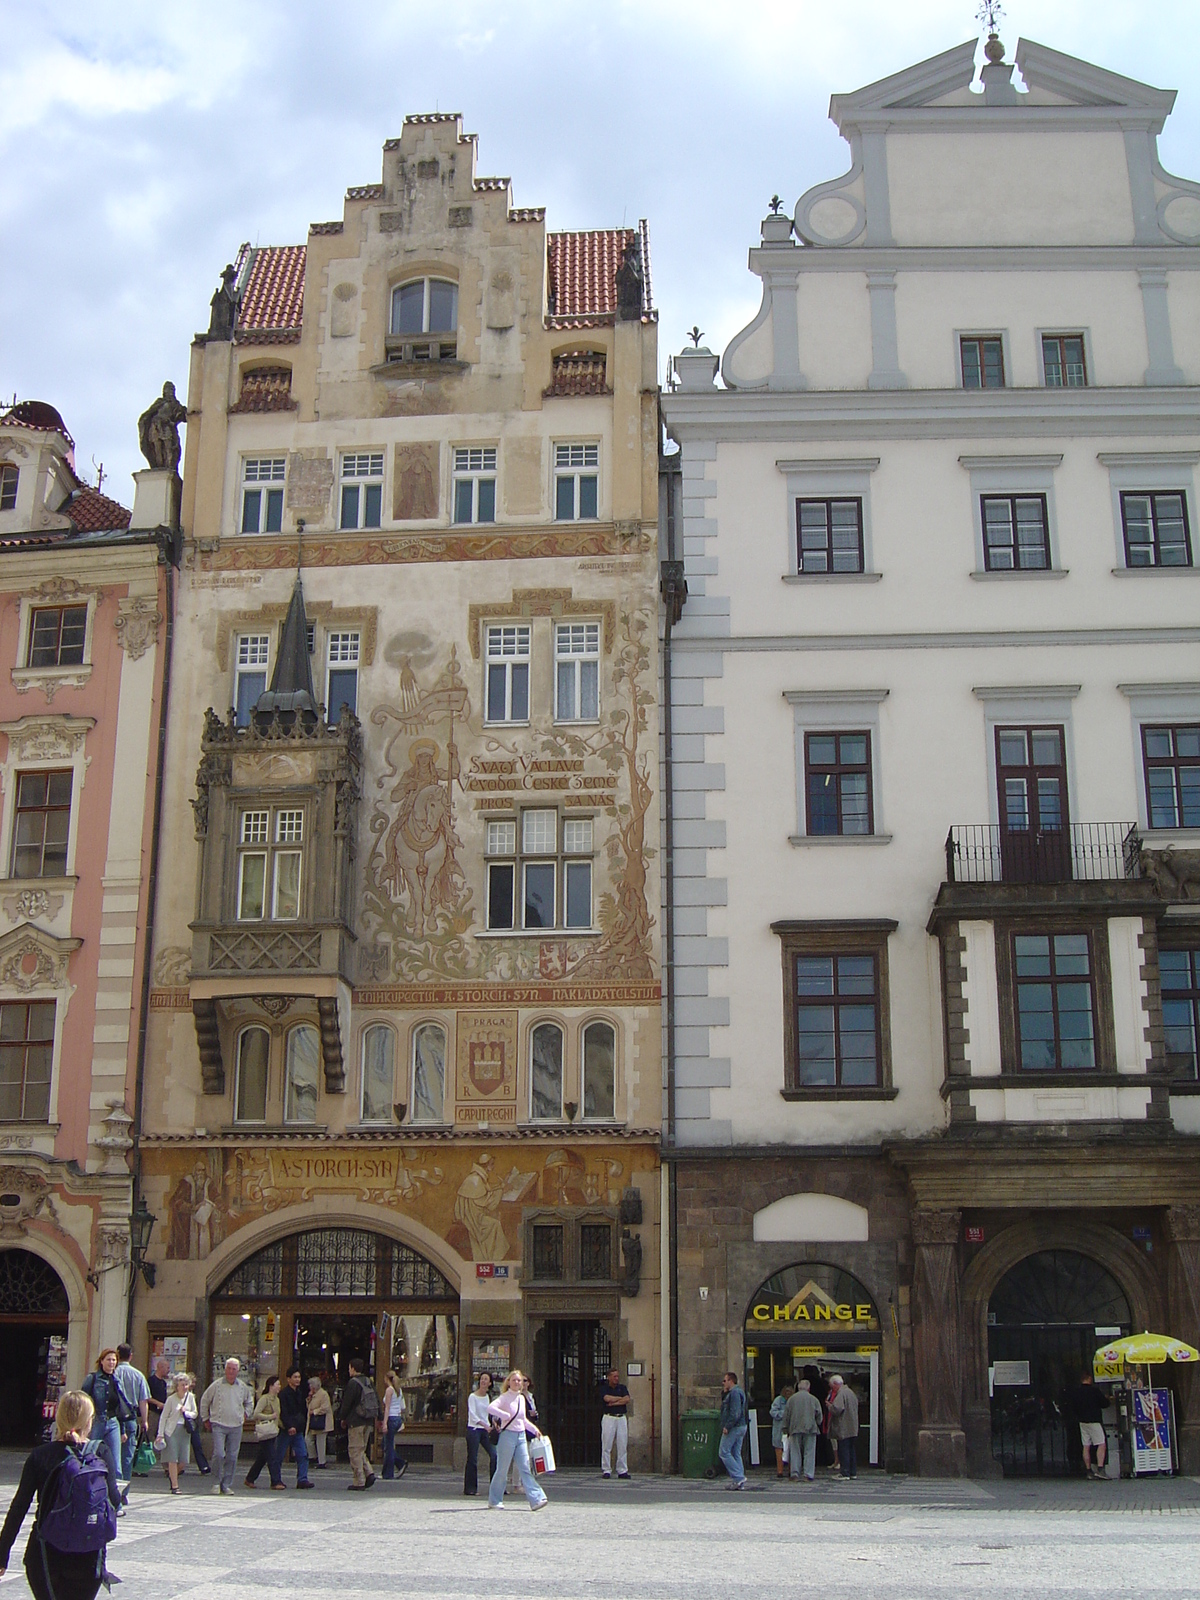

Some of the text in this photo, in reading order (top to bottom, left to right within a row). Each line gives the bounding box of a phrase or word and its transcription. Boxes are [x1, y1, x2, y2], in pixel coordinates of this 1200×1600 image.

[480, 797, 513, 809] PROS
[463, 1085, 471, 1097] R
[503, 1085, 511, 1096] B
[753, 1303, 872, 1321] CHANGE
[43, 1405, 55, 1418] 11
